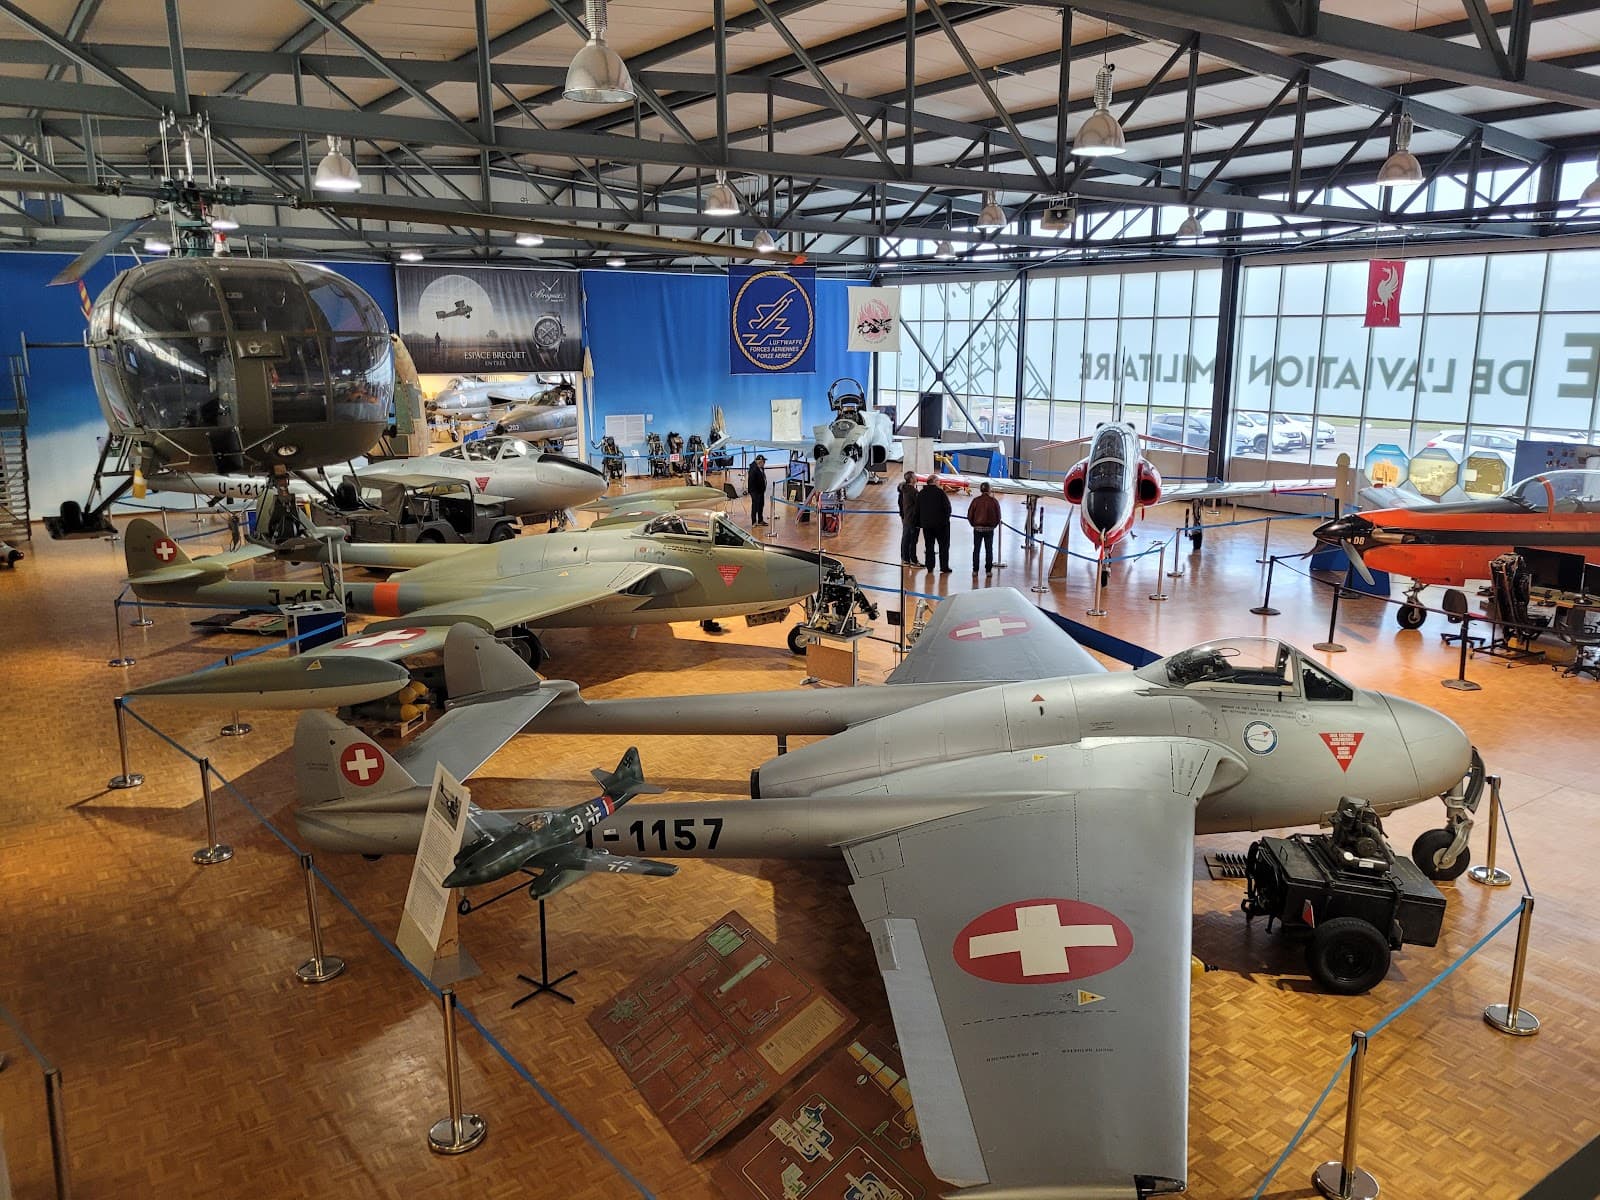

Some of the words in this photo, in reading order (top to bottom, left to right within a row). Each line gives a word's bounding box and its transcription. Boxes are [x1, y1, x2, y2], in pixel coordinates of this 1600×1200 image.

[464, 351, 490, 360] ESPACE
[492, 351, 526, 359] BREGUET
[571, 814, 584, 834] 3
